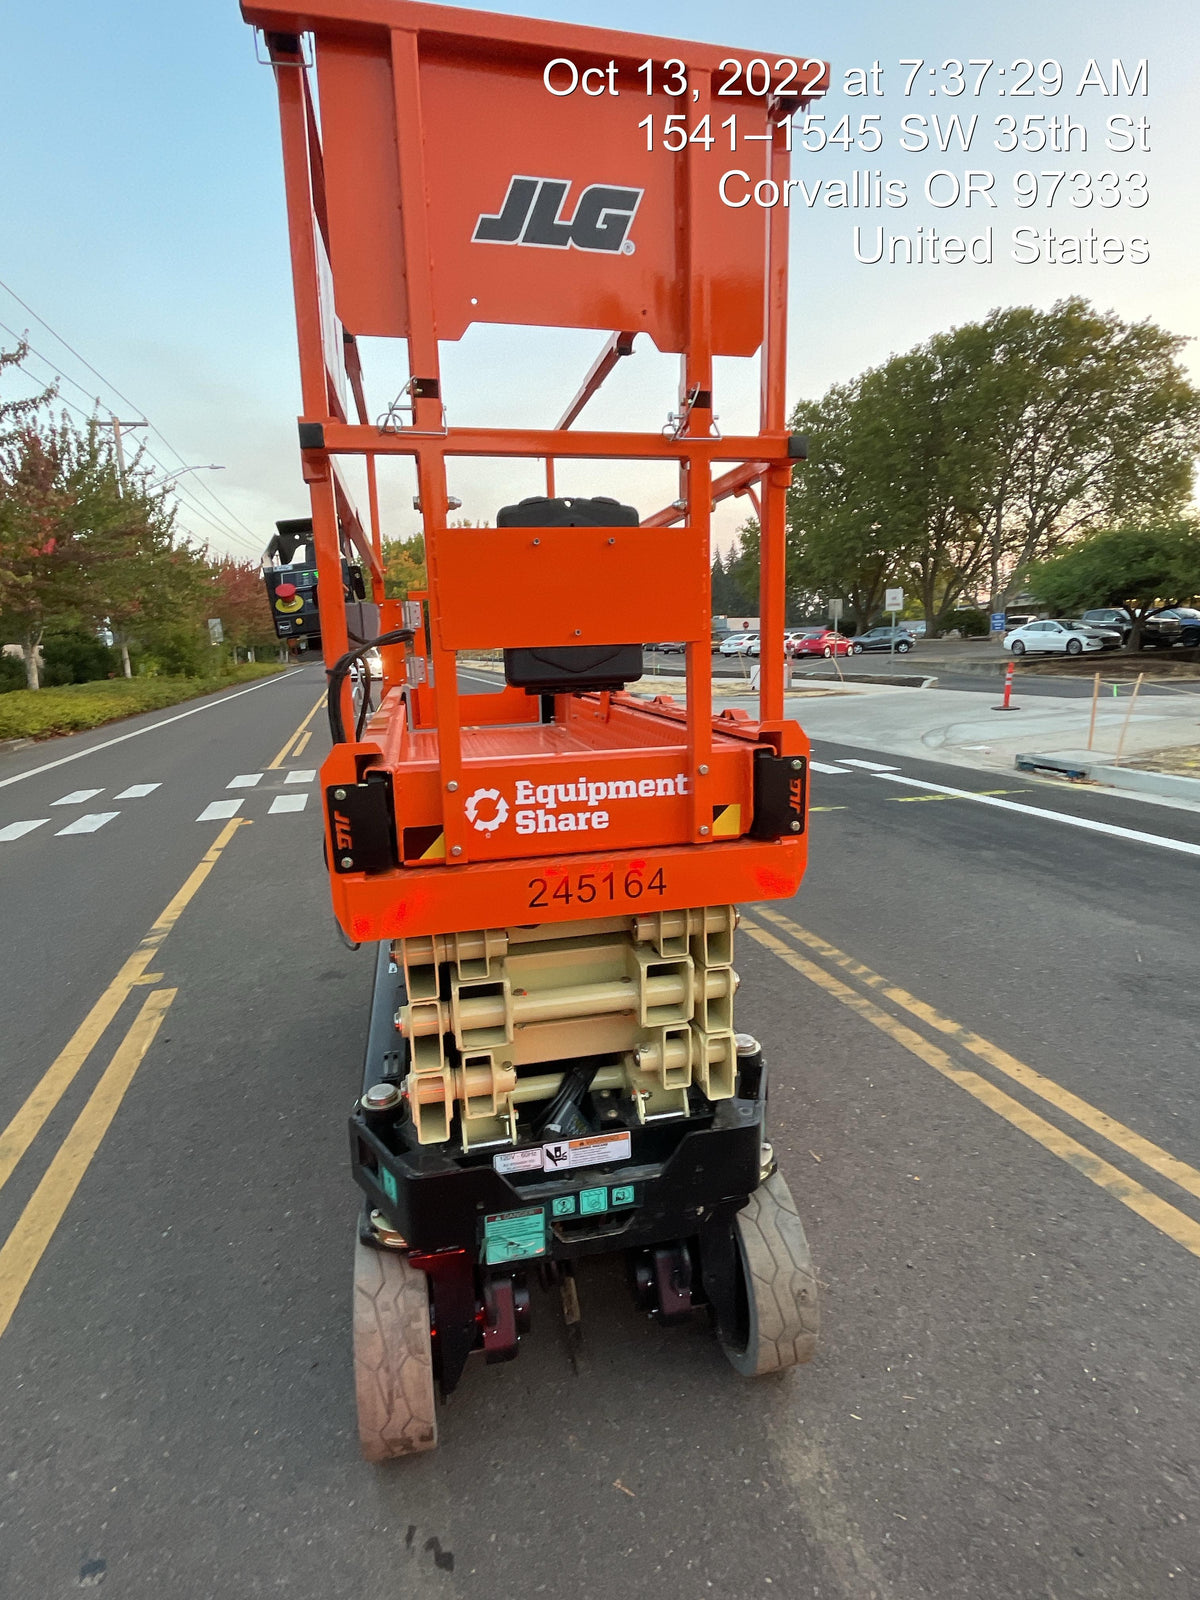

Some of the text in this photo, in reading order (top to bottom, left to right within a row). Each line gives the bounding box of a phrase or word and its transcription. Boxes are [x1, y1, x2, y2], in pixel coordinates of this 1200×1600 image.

[471, 175, 645, 254] JLG
[515, 773, 693, 809] Equipment
[515, 809, 609, 834] Share
[528, 867, 667, 908] 245164
